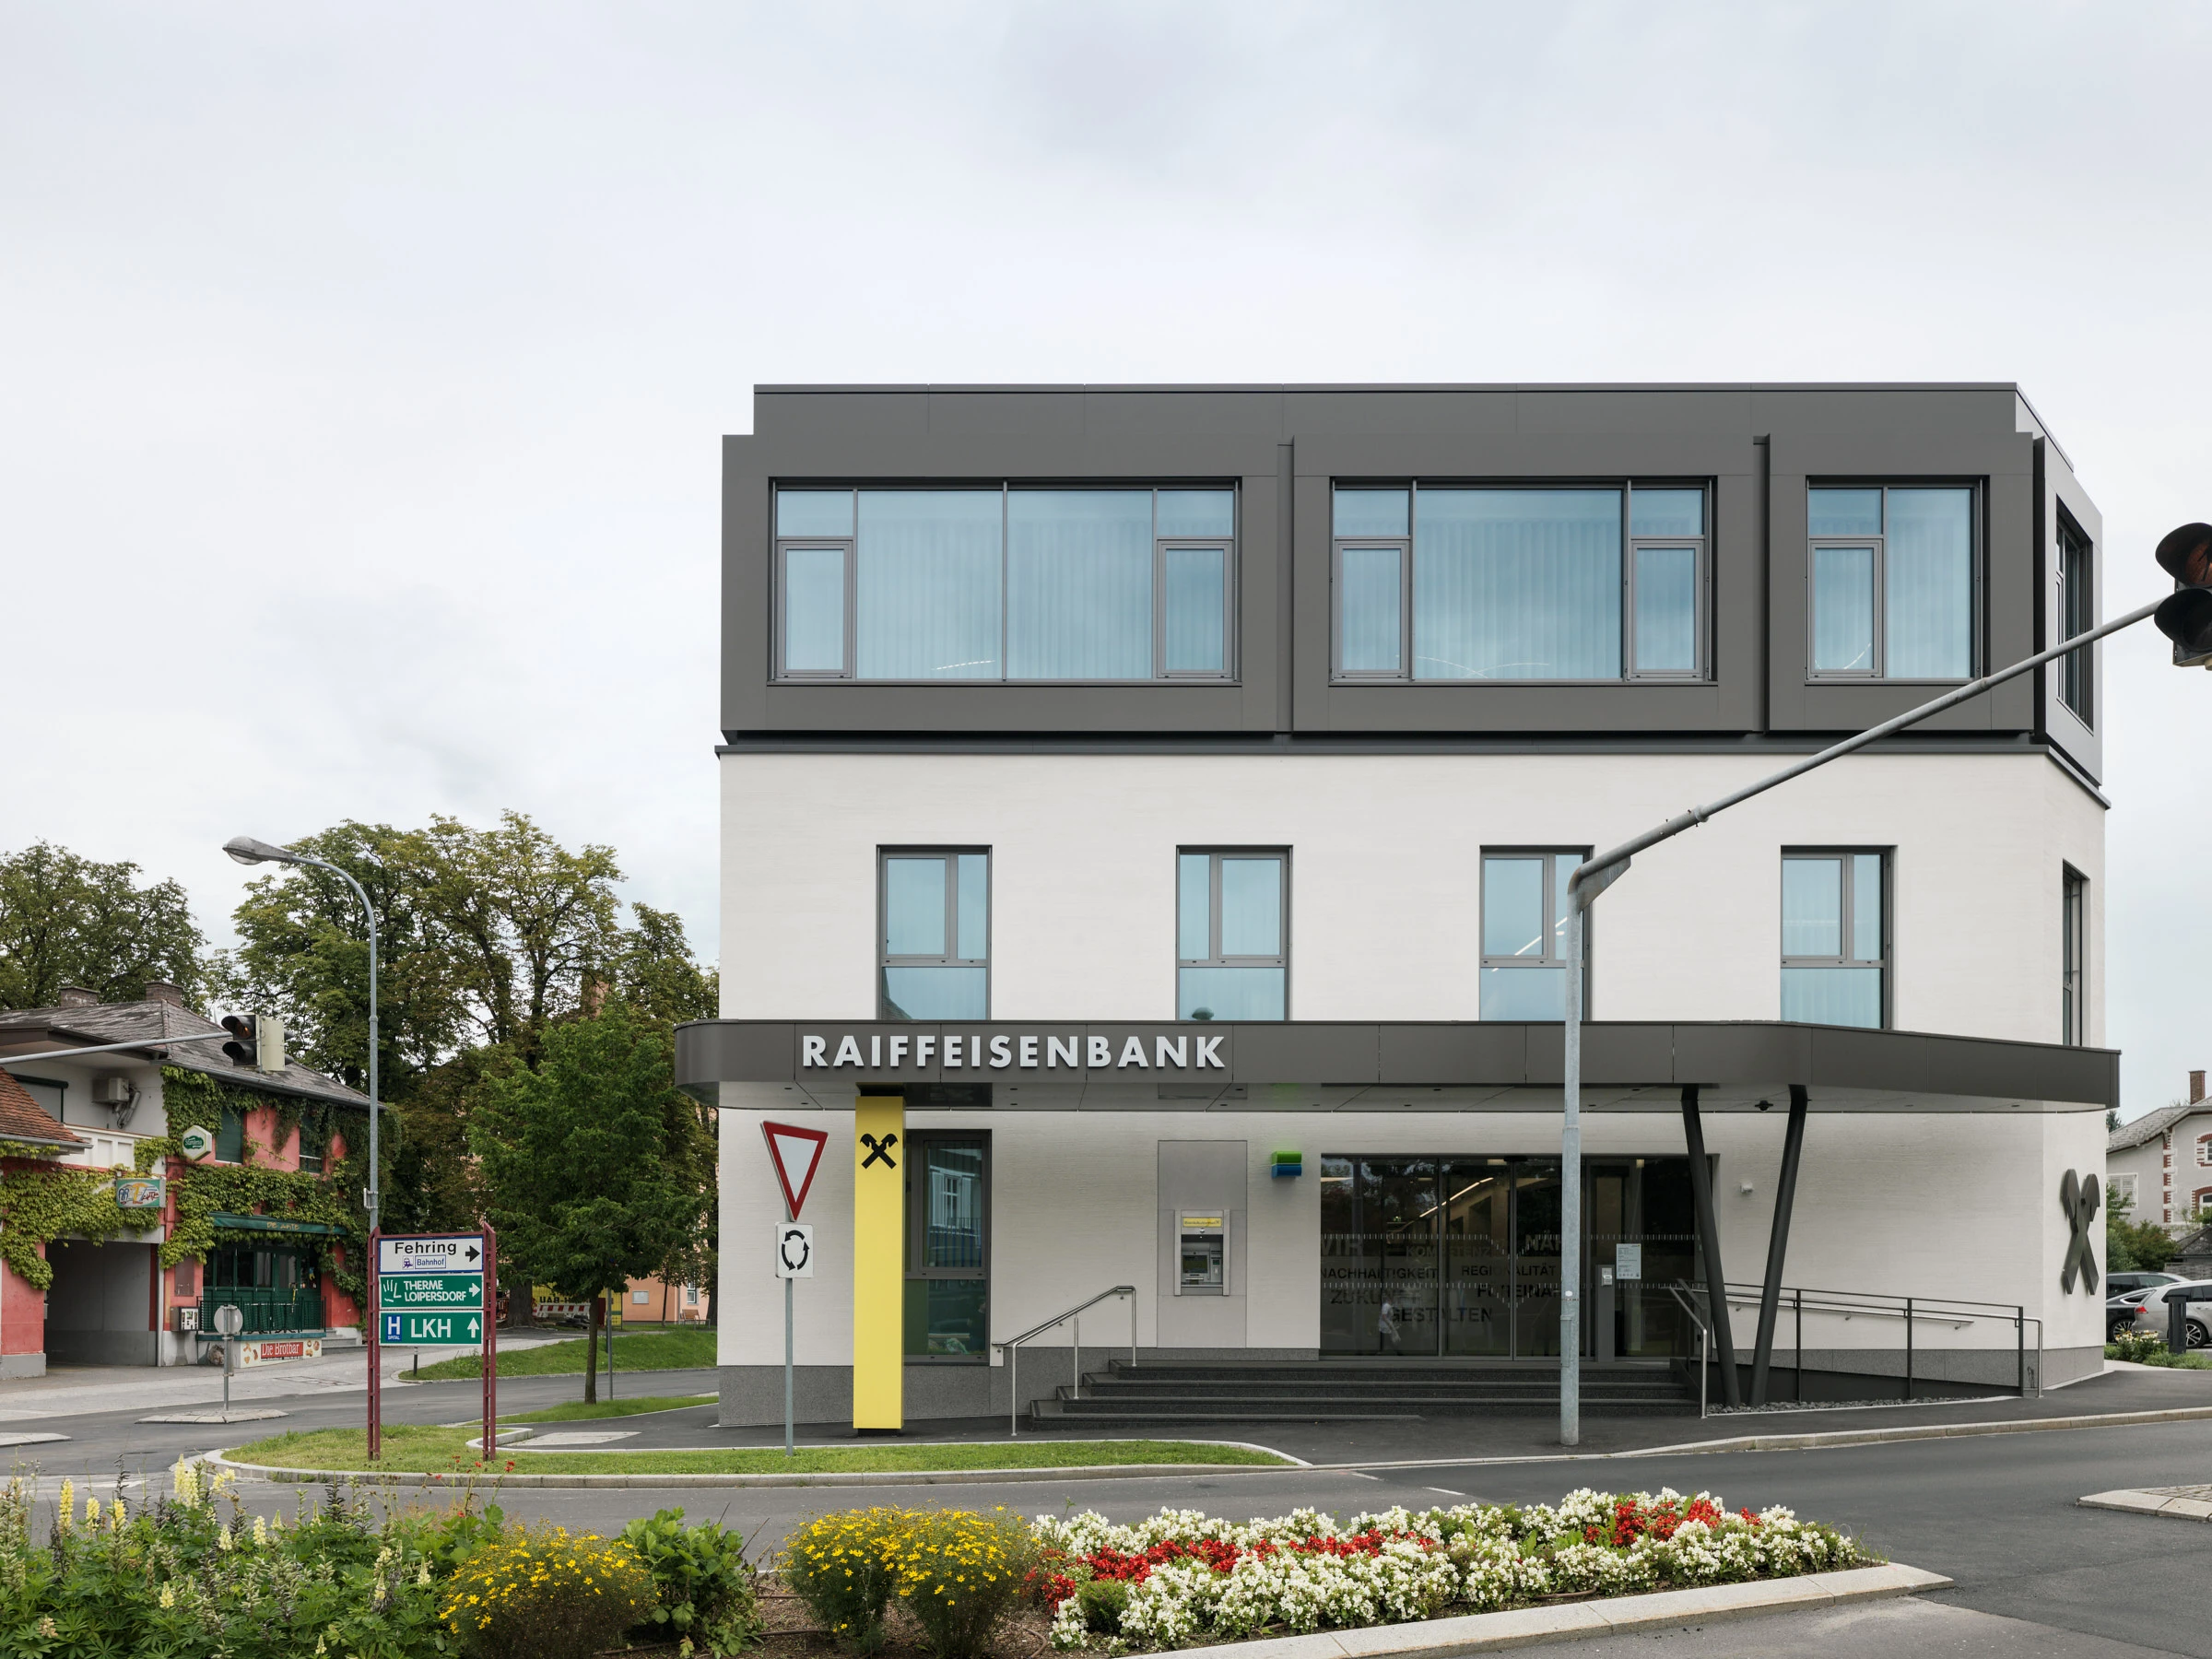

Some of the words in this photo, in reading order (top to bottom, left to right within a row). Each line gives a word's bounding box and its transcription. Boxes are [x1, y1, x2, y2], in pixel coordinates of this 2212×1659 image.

[803, 1035, 1225, 1068] RAIFFEISENBANK
[394, 1241, 457, 1255] Fehring
[417, 1257, 444, 1266] Bahnhof
[404, 1279, 443, 1290] THERME
[404, 1290, 466, 1302] LOIPERSDORF
[387, 1316, 401, 1335] H
[411, 1318, 452, 1338] LKH
[262, 1343, 273, 1356] Die
[275, 1343, 300, 1355] Brotbar
